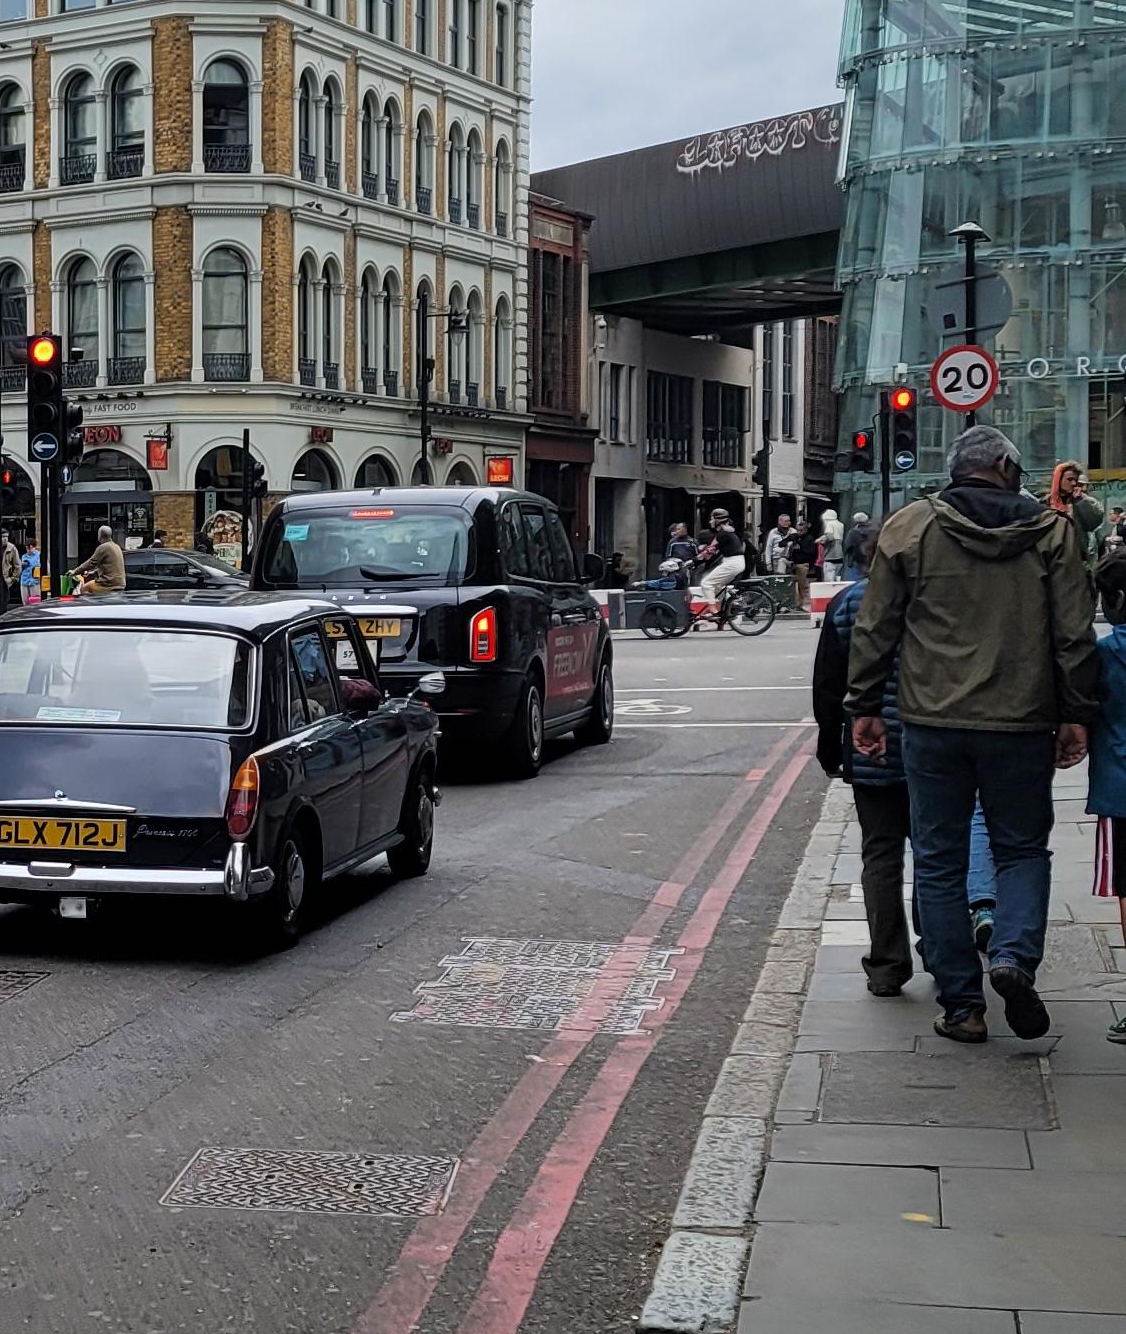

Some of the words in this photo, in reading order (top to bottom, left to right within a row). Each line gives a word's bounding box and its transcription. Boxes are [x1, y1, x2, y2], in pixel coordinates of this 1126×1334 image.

[941, 362, 989, 394] 20
[94, 403, 112, 412] FAST
[114, 402, 137, 412] FOOD
[83, 425, 121, 444] EON
[365, 619, 395, 634] ZHY
[56, 821, 118, 847] 712J
